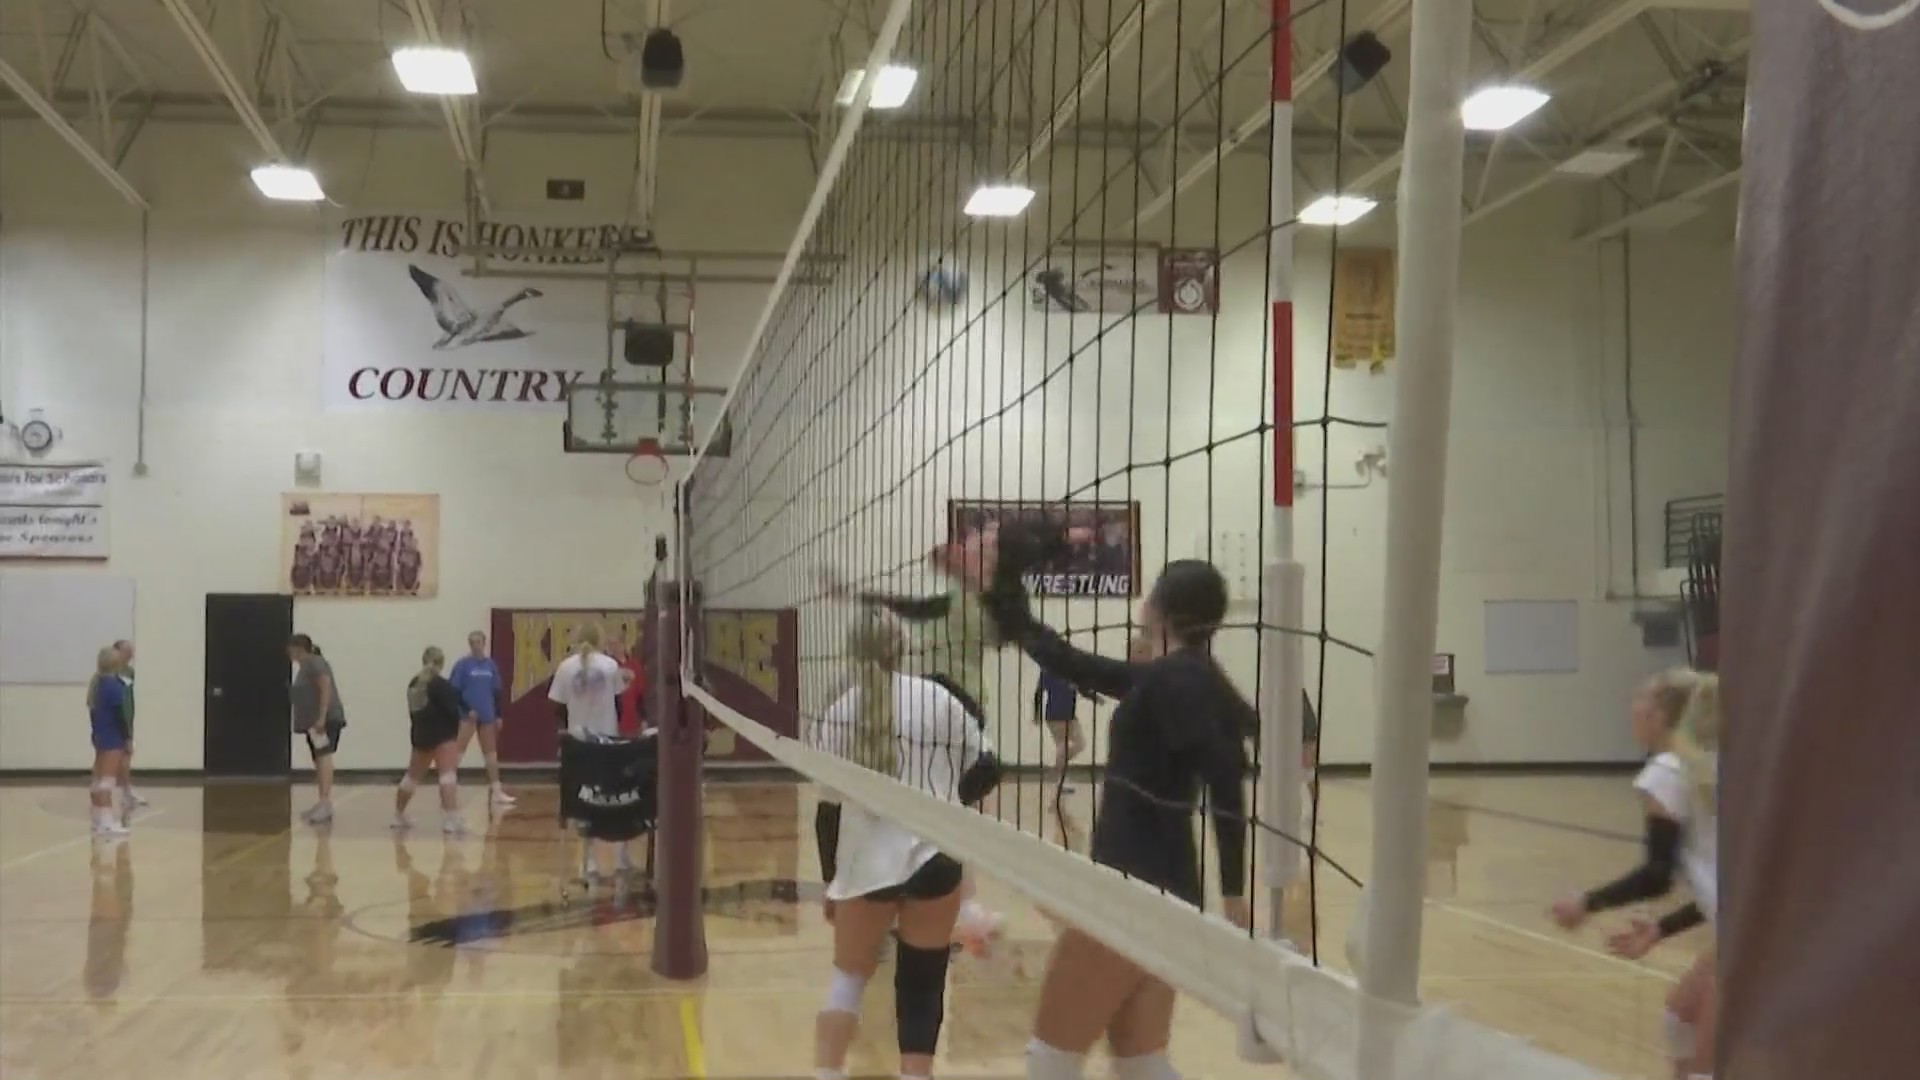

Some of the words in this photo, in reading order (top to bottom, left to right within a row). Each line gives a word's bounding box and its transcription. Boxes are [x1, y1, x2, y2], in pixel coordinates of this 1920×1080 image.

[341, 215, 421, 252] THIS
[427, 219, 463, 258] IS
[348, 366, 583, 401] COUNTRY
[1022, 573, 1130, 594] WRESTLING
